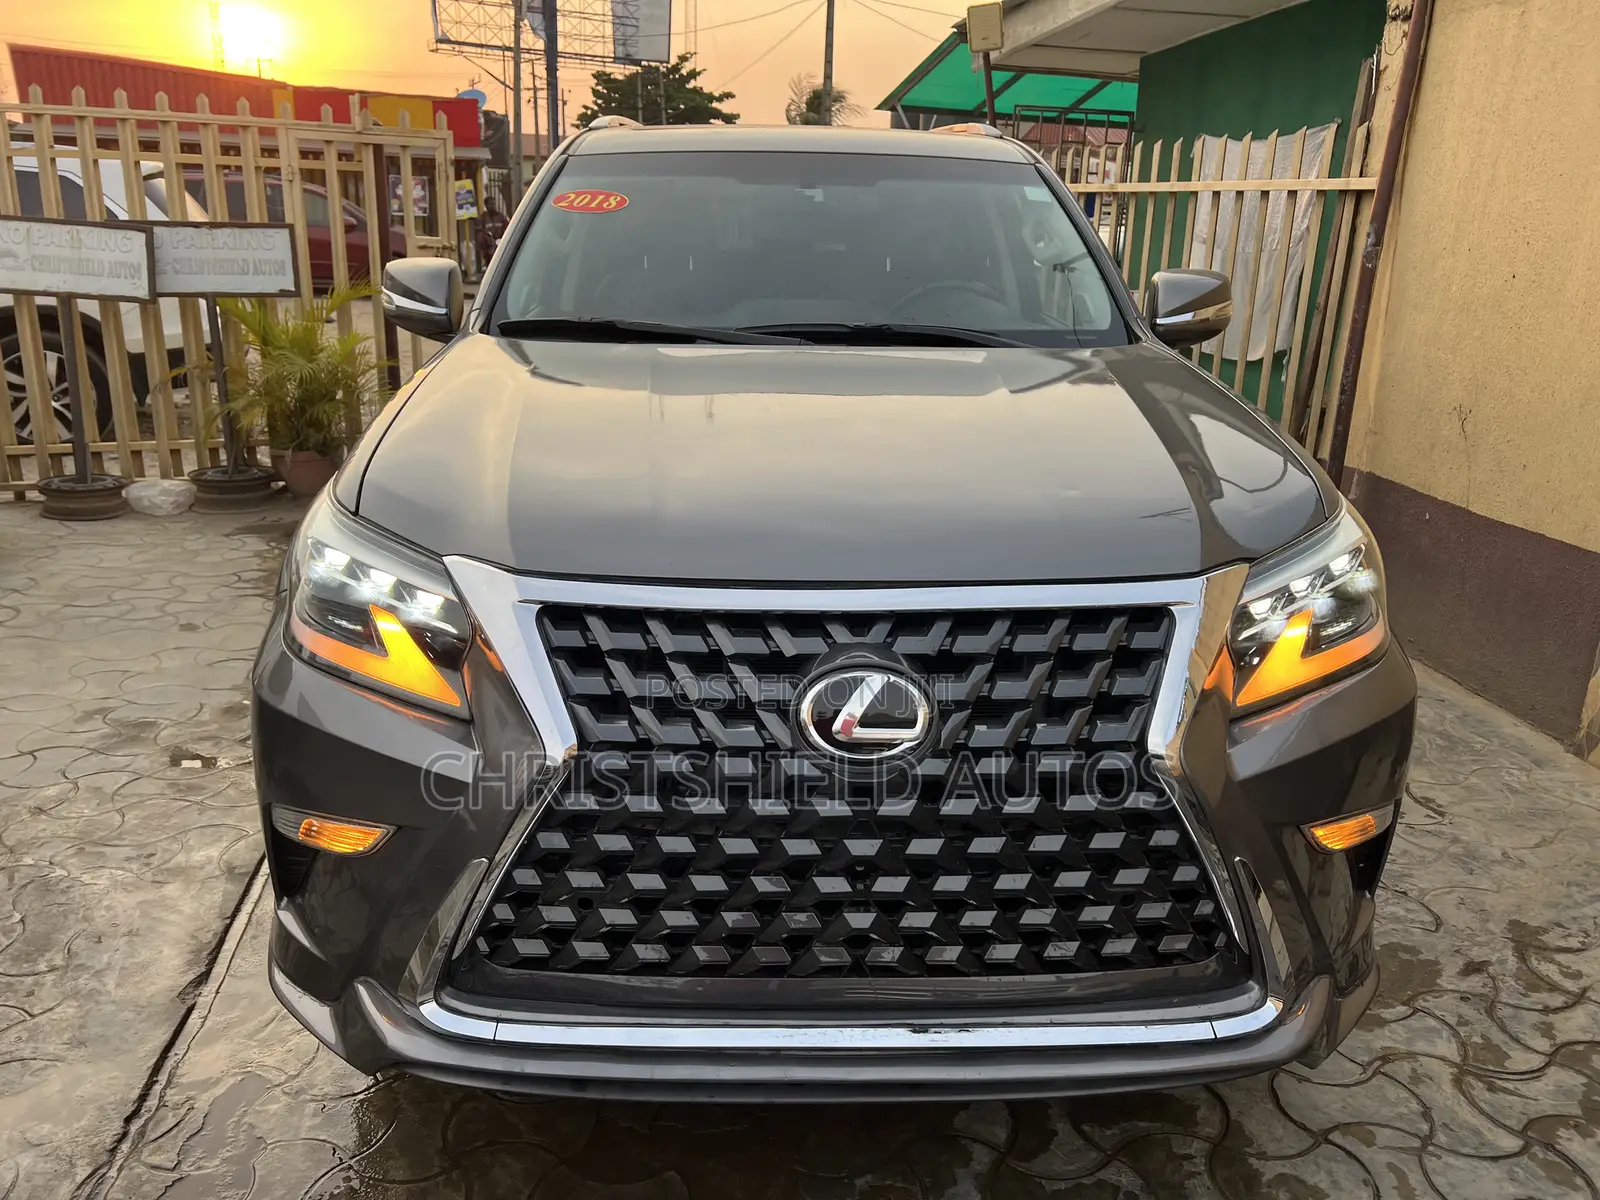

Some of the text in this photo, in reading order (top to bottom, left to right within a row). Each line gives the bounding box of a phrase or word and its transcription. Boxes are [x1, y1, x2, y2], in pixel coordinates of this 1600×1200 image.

[557, 193, 621, 209] 2018
[29, 224, 133, 254] PARKING
[170, 229, 278, 251] PARKING
[106, 259, 142, 281] AUTOS
